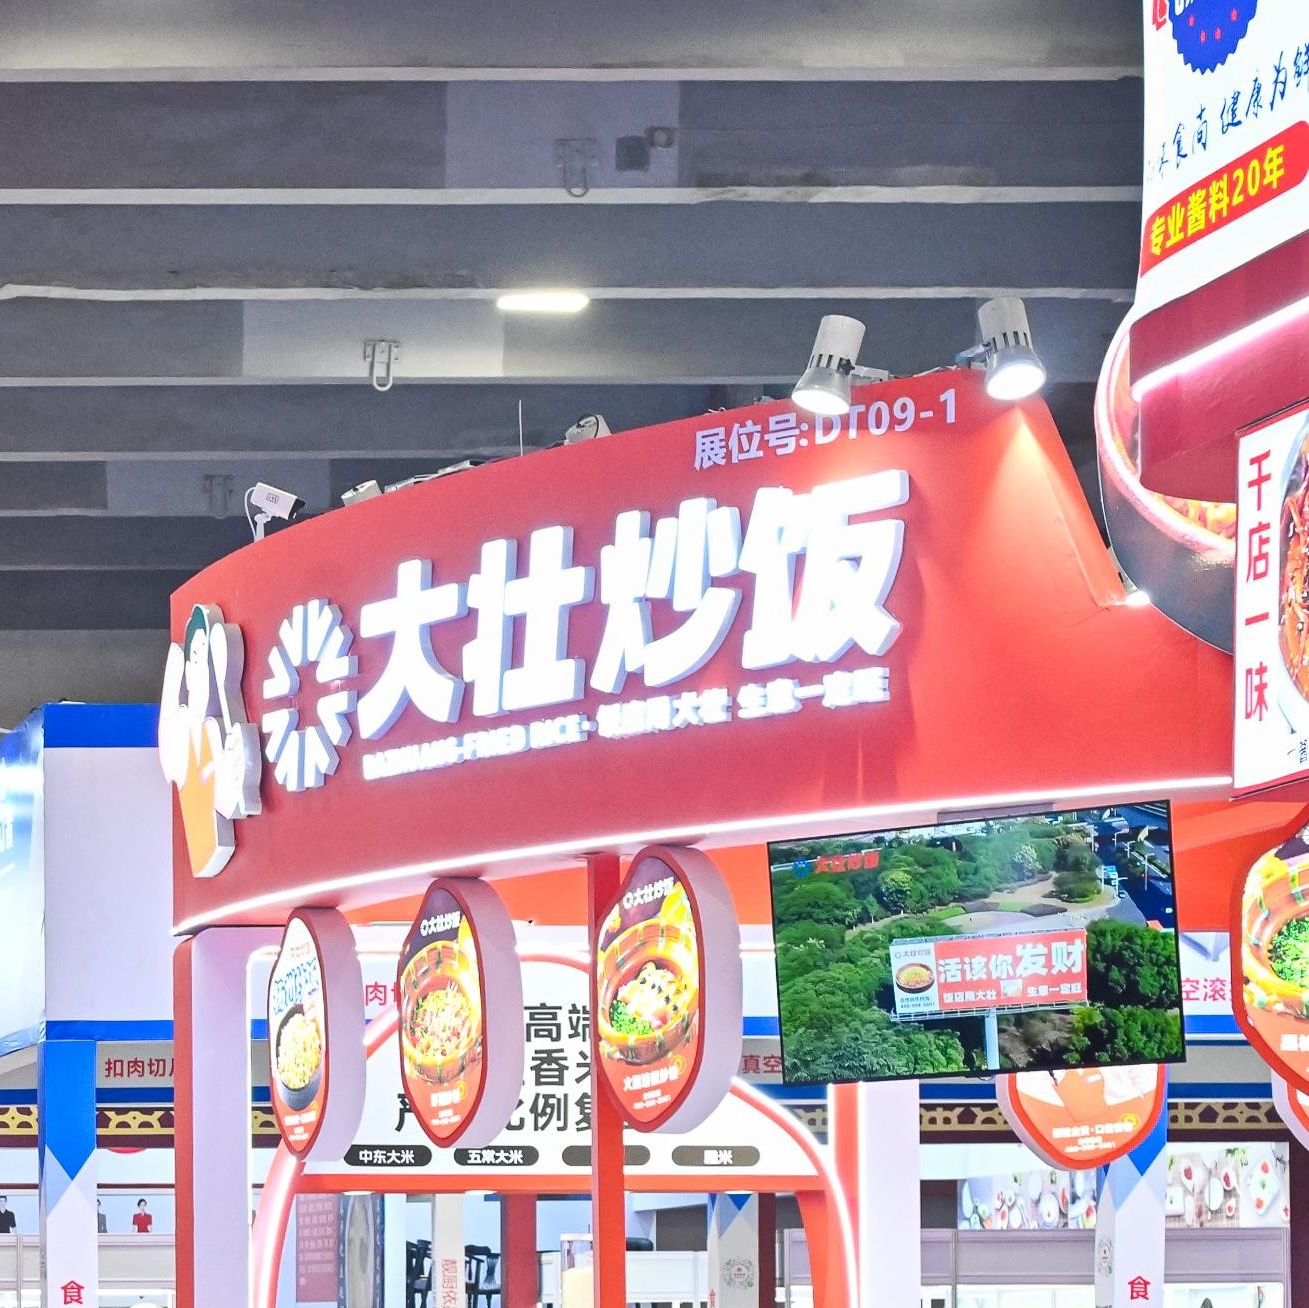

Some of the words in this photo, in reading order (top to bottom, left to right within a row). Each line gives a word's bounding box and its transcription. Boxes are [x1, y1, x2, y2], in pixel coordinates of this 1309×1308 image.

[1150, 144, 1285, 257] 专业酱料20年
[359, 469, 909, 740] 大壮炒饭
[1244, 449, 1271, 722] 千店一味
[938, 938, 1085, 984] 活该你发财
[1181, 977, 1232, 1002] 空滚
[358, 1150, 415, 1164] 中东大米
[467, 1150, 524, 1164] 五常大米
